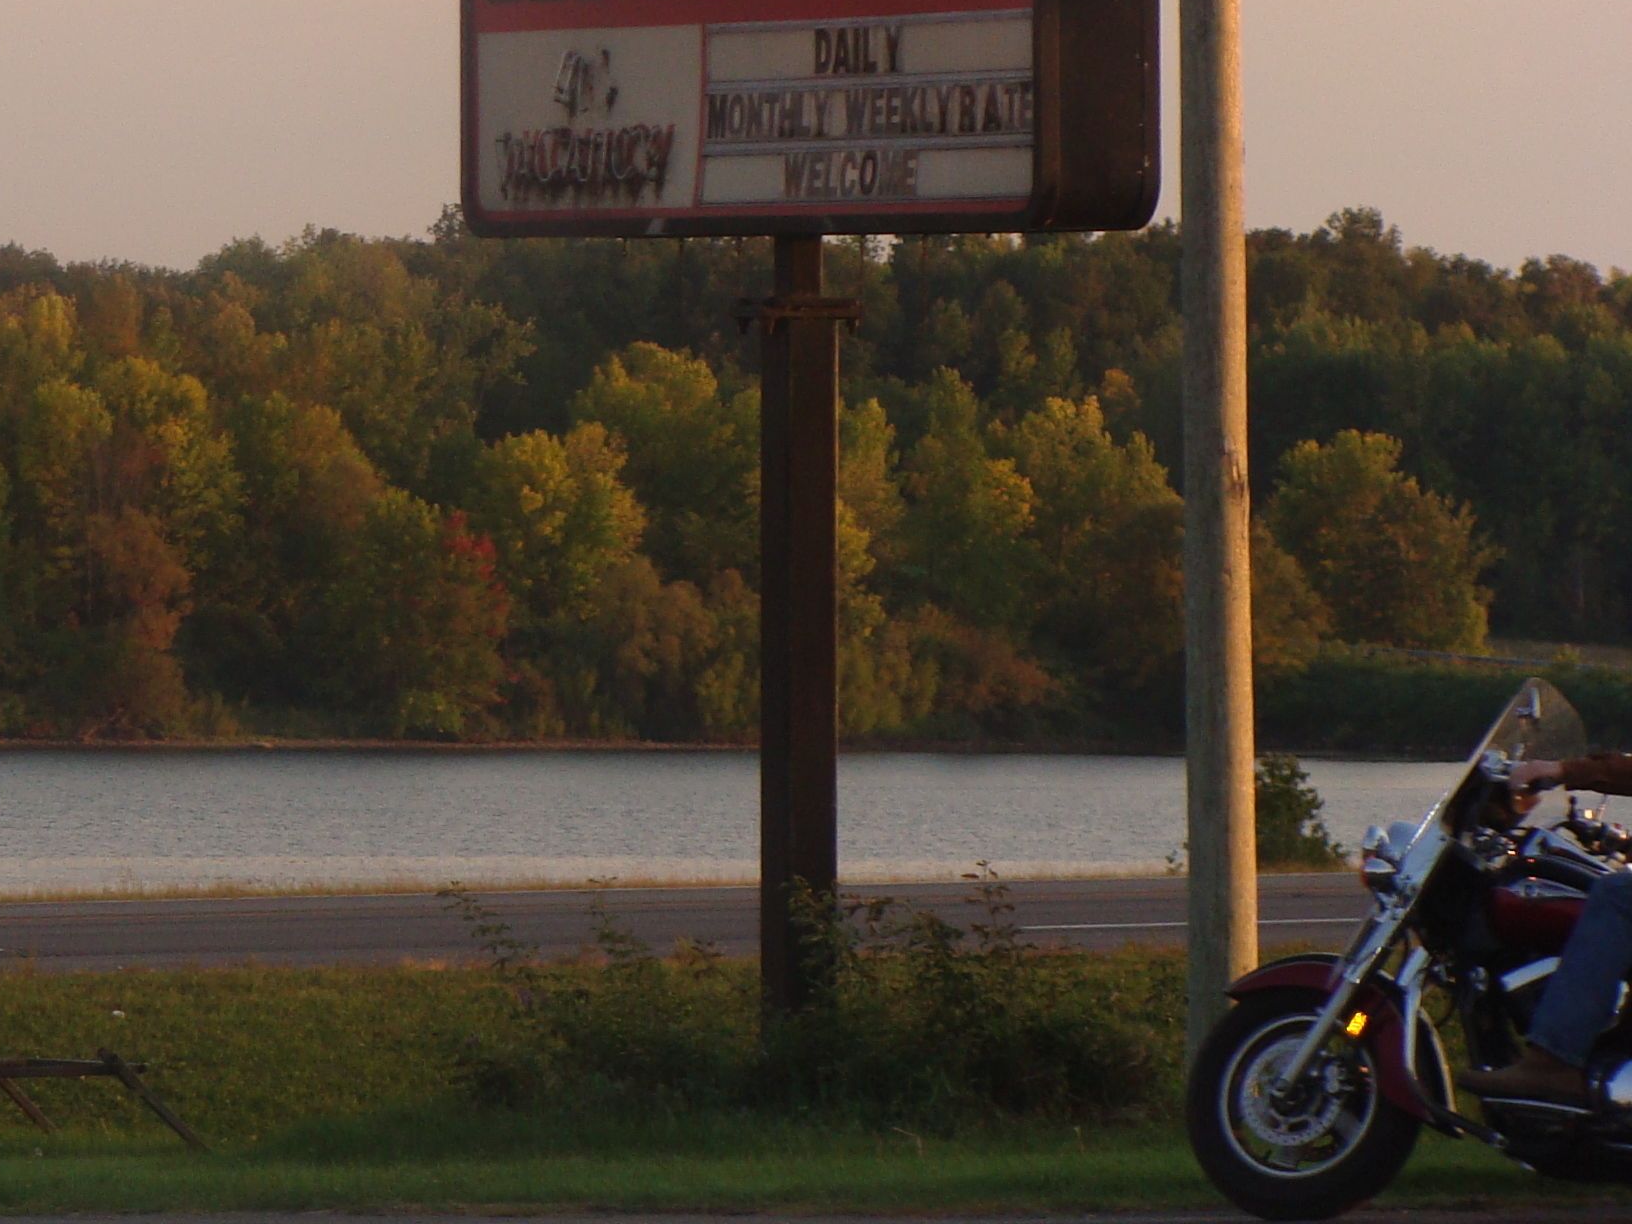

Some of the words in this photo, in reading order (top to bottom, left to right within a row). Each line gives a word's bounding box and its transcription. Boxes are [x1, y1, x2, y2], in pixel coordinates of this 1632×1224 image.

[814, 25, 901, 75] DAILY
[707, 86, 829, 140] MONTHLY
[845, 81, 956, 136] WEEKLY
[784, 148, 917, 198] WELCOME
